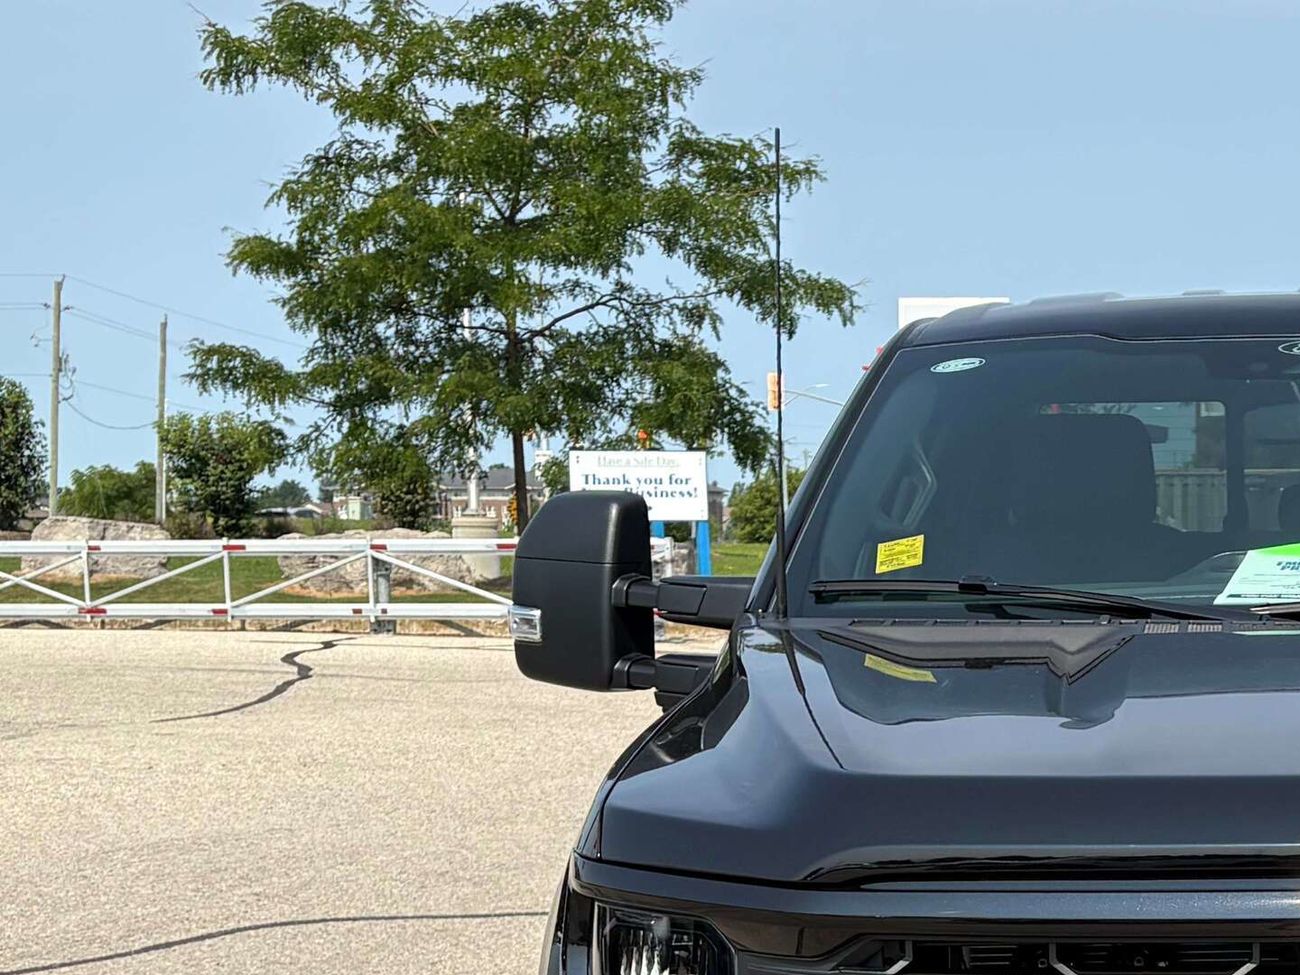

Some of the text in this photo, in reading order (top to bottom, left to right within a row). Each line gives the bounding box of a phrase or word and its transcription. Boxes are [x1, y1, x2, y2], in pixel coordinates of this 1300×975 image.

[582, 473, 691, 486] Thank you for
